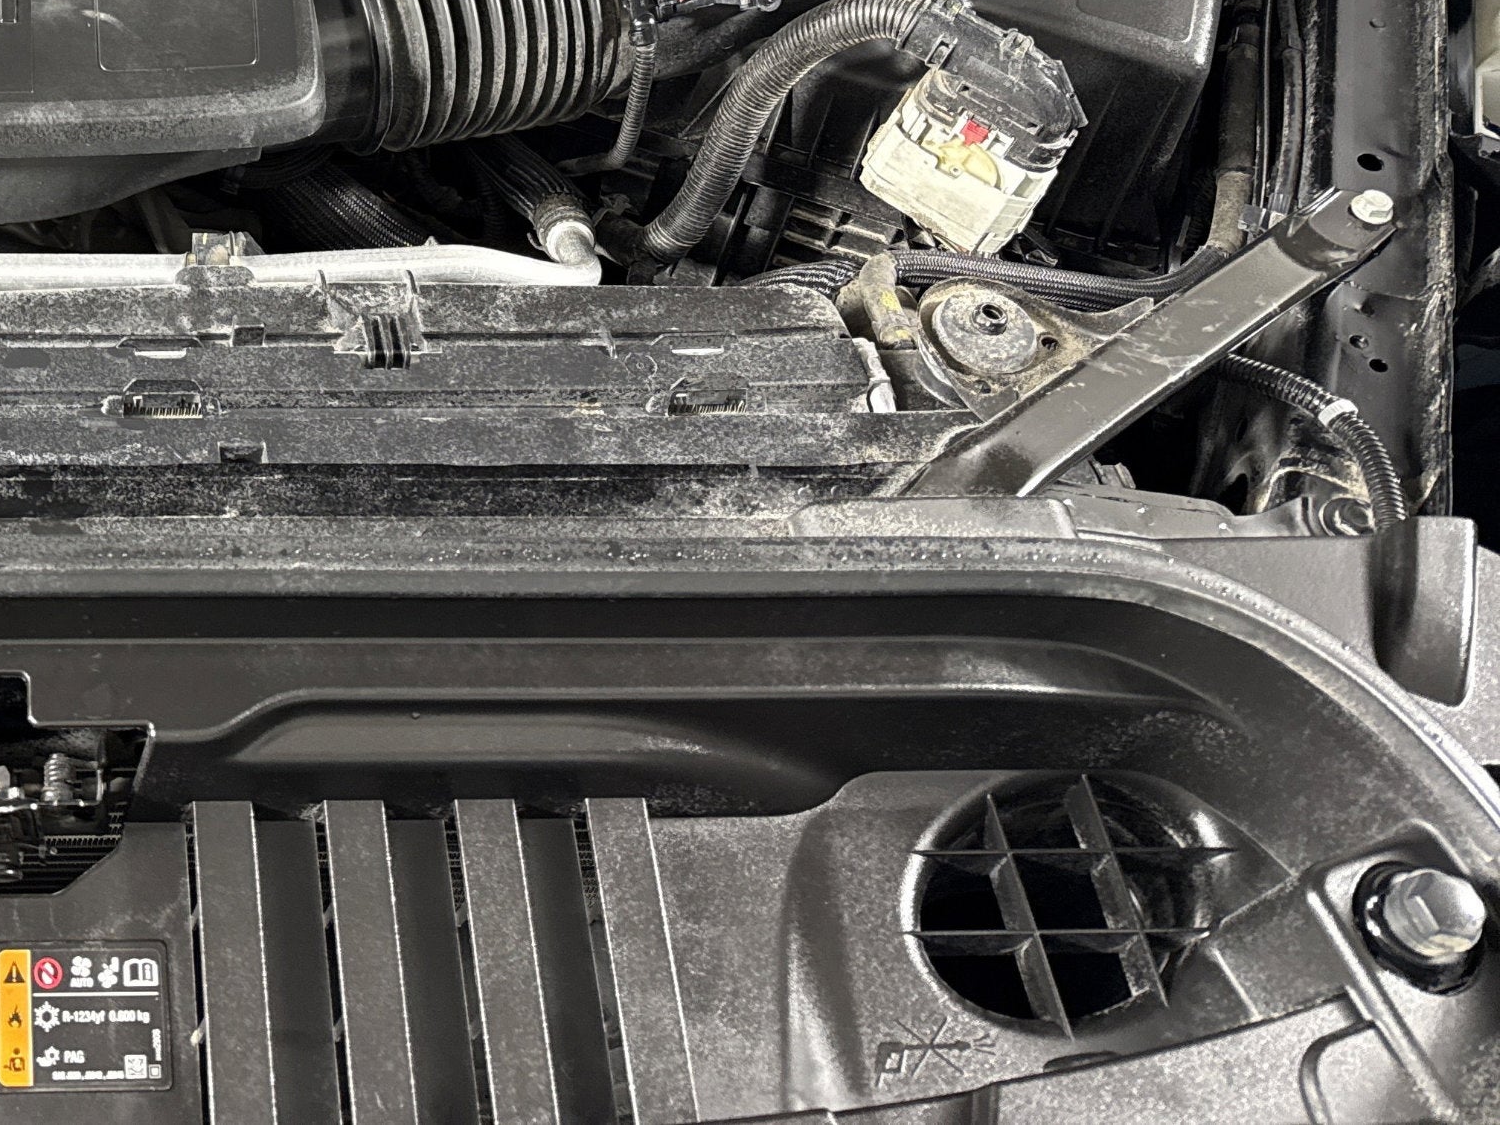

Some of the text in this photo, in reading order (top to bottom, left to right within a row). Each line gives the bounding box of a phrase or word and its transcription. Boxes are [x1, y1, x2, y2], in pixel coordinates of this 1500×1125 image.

[70, 977, 94, 988] AUTO
[137, 1009, 150, 1024] kg
[63, 1050, 85, 1063] PAG
